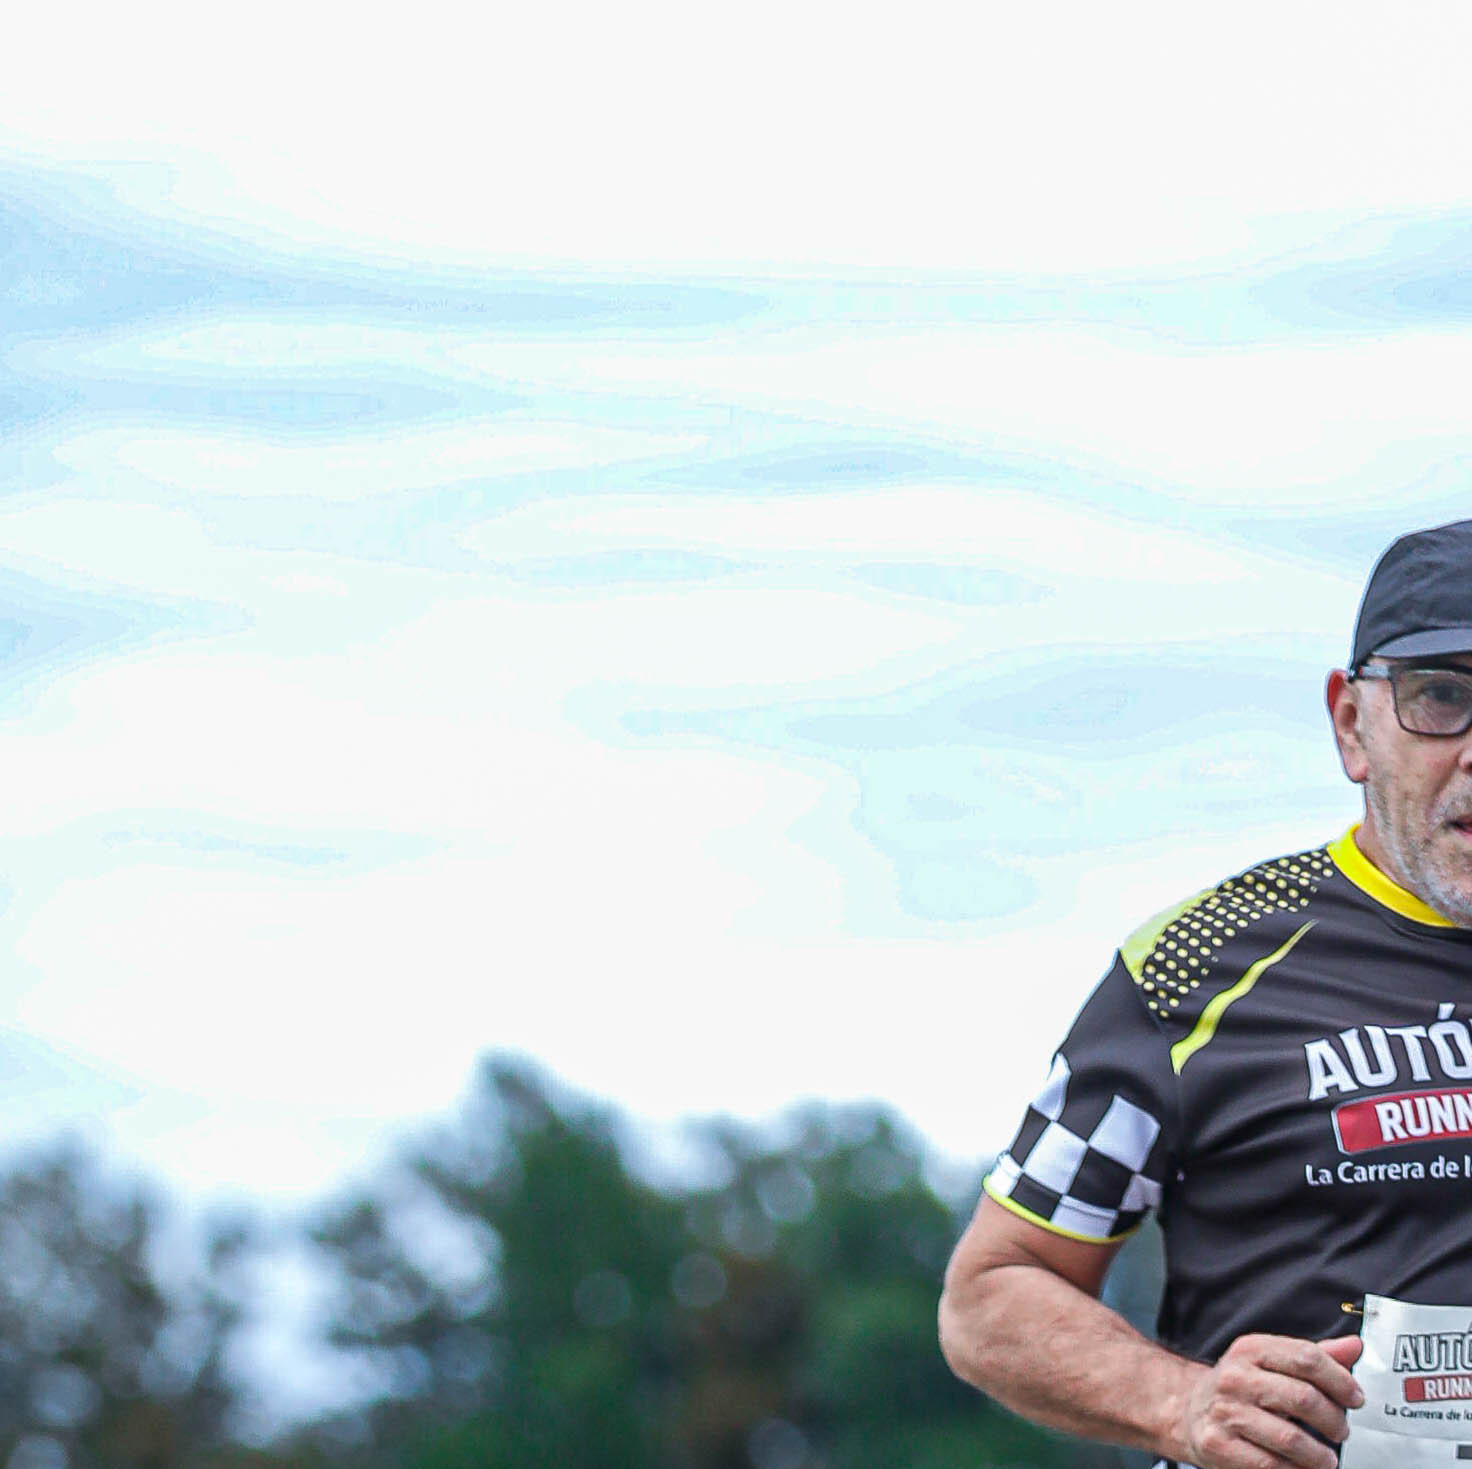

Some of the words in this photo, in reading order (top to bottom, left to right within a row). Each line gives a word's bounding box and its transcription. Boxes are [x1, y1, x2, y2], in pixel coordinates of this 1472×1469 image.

[1305, 1164, 1332, 1186] La
[1337, 1159, 1425, 1183] Carrera
[1429, 1156, 1460, 1178] de
[1384, 1404, 1397, 1415] La
